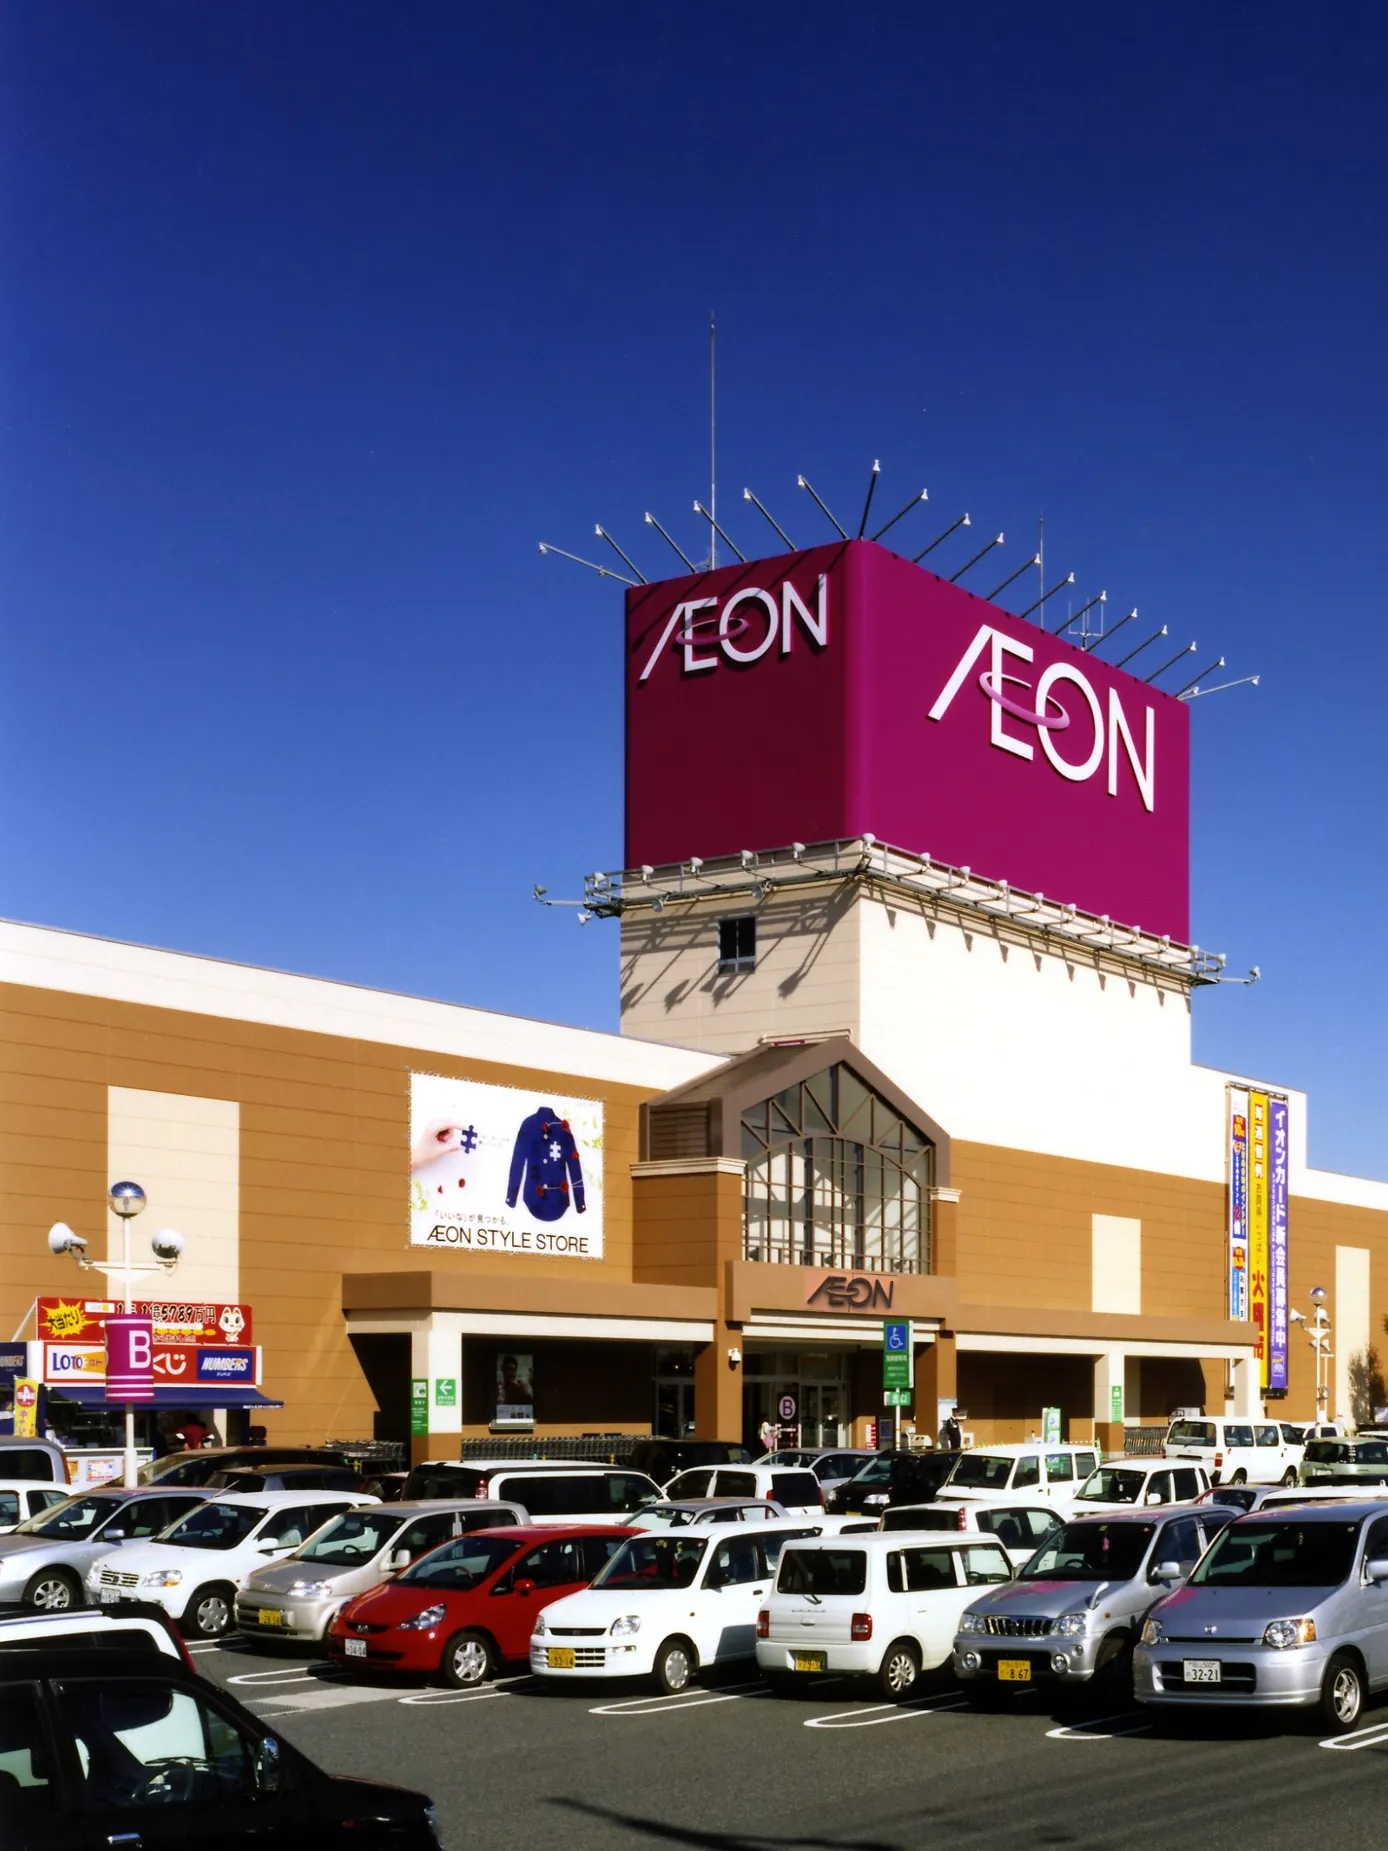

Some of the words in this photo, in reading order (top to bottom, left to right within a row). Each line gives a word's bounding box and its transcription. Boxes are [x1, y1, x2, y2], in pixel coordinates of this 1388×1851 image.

[477, 1228, 532, 1248] STYLE
[536, 1233, 589, 1253] STORE
[129, 1330, 150, 1369] B
[52, 1352, 84, 1371] LOTO
[201, 1356, 249, 1372] NUMBERS
[782, 1399, 793, 1416] B
[1192, 1668, 1219, 1681] 32-21
